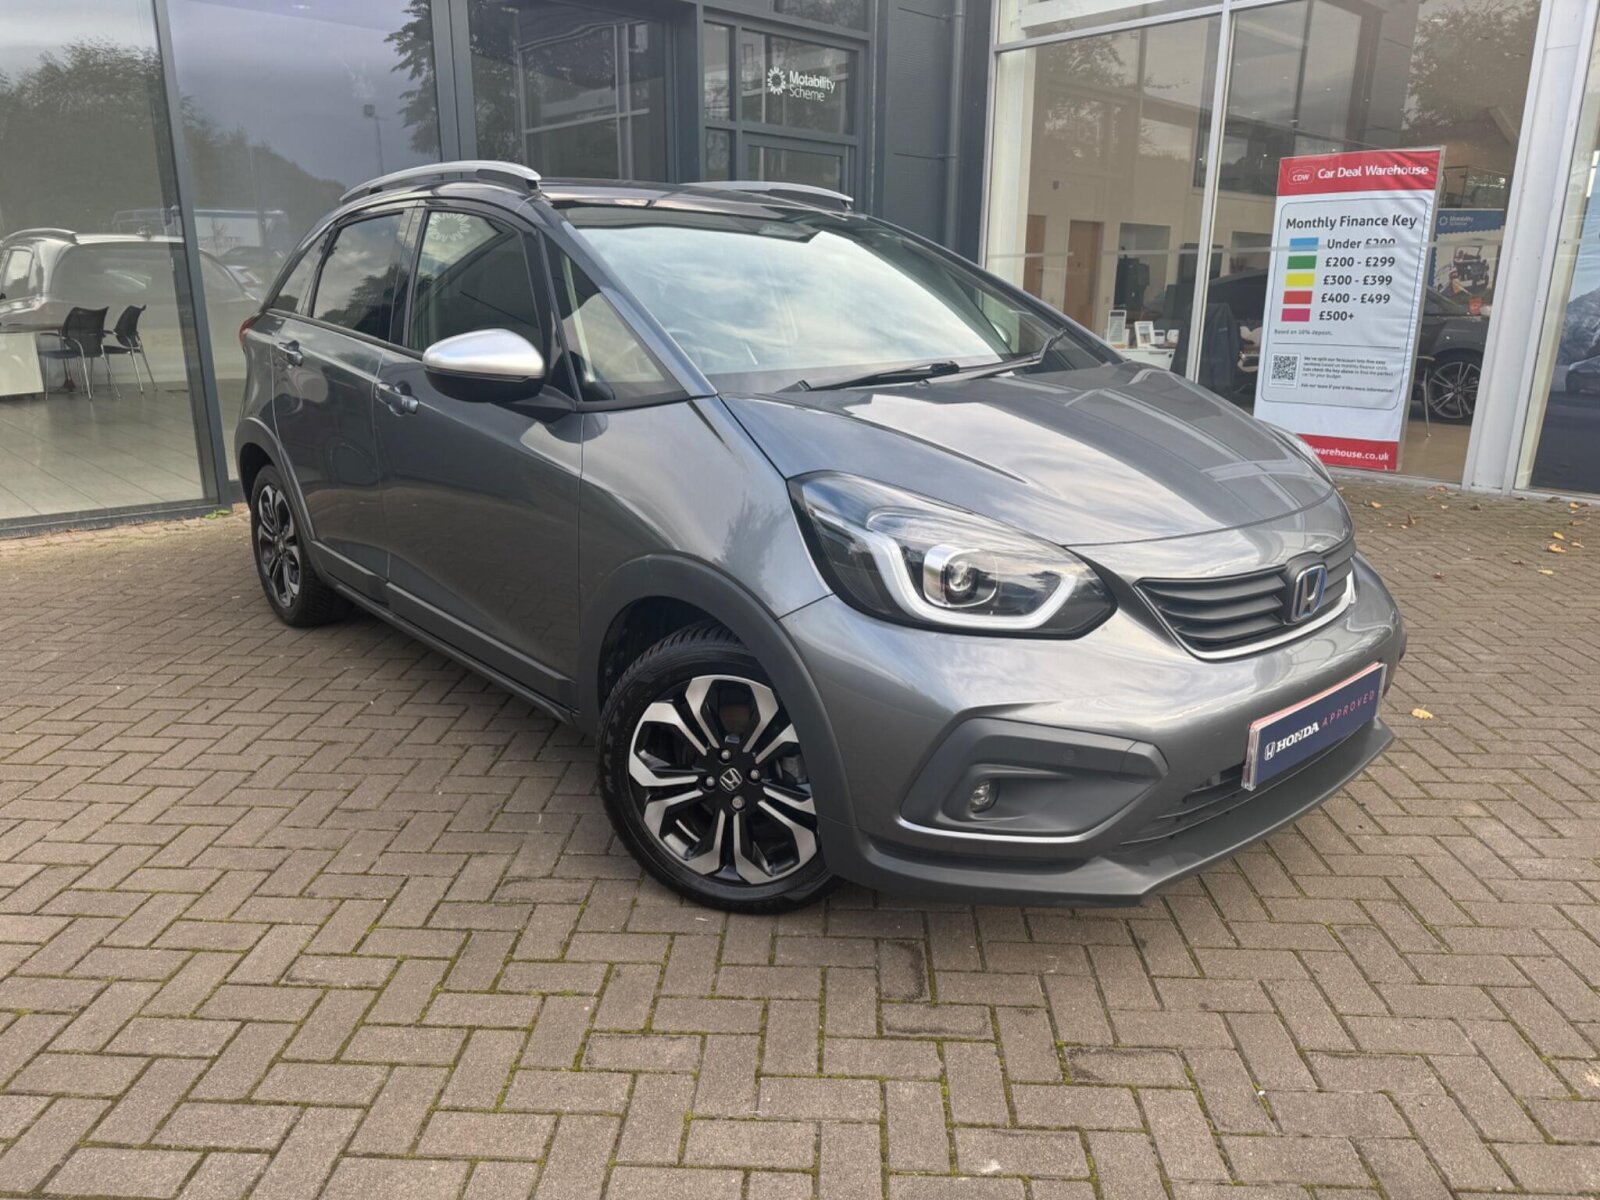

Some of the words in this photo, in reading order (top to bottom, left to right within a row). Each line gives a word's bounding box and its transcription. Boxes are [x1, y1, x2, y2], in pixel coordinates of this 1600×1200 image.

[789, 70, 836, 94] Motability
[789, 84, 826, 102] Scheme
[1292, 173, 1310, 182] CDW
[1318, 168, 1336, 180] Car
[1337, 166, 1362, 178] Deal
[1365, 165, 1429, 176] Warehouse
[1286, 216, 1338, 231] Monthly
[1340, 215, 1389, 227] Finance
[1392, 214, 1418, 230] Key
[1327, 238, 1362, 249] Under
[1325, 256, 1355, 268] £200
[1365, 256, 1396, 268] £299
[1323, 275, 1353, 286] £300
[1363, 275, 1393, 286] £399
[1321, 293, 1350, 304] £400
[1360, 293, 1391, 304] £499
[1318, 310, 1355, 321] £500+
[1276, 722, 1320, 753] HONDA
[1321, 690, 1375, 728] APPROVED
